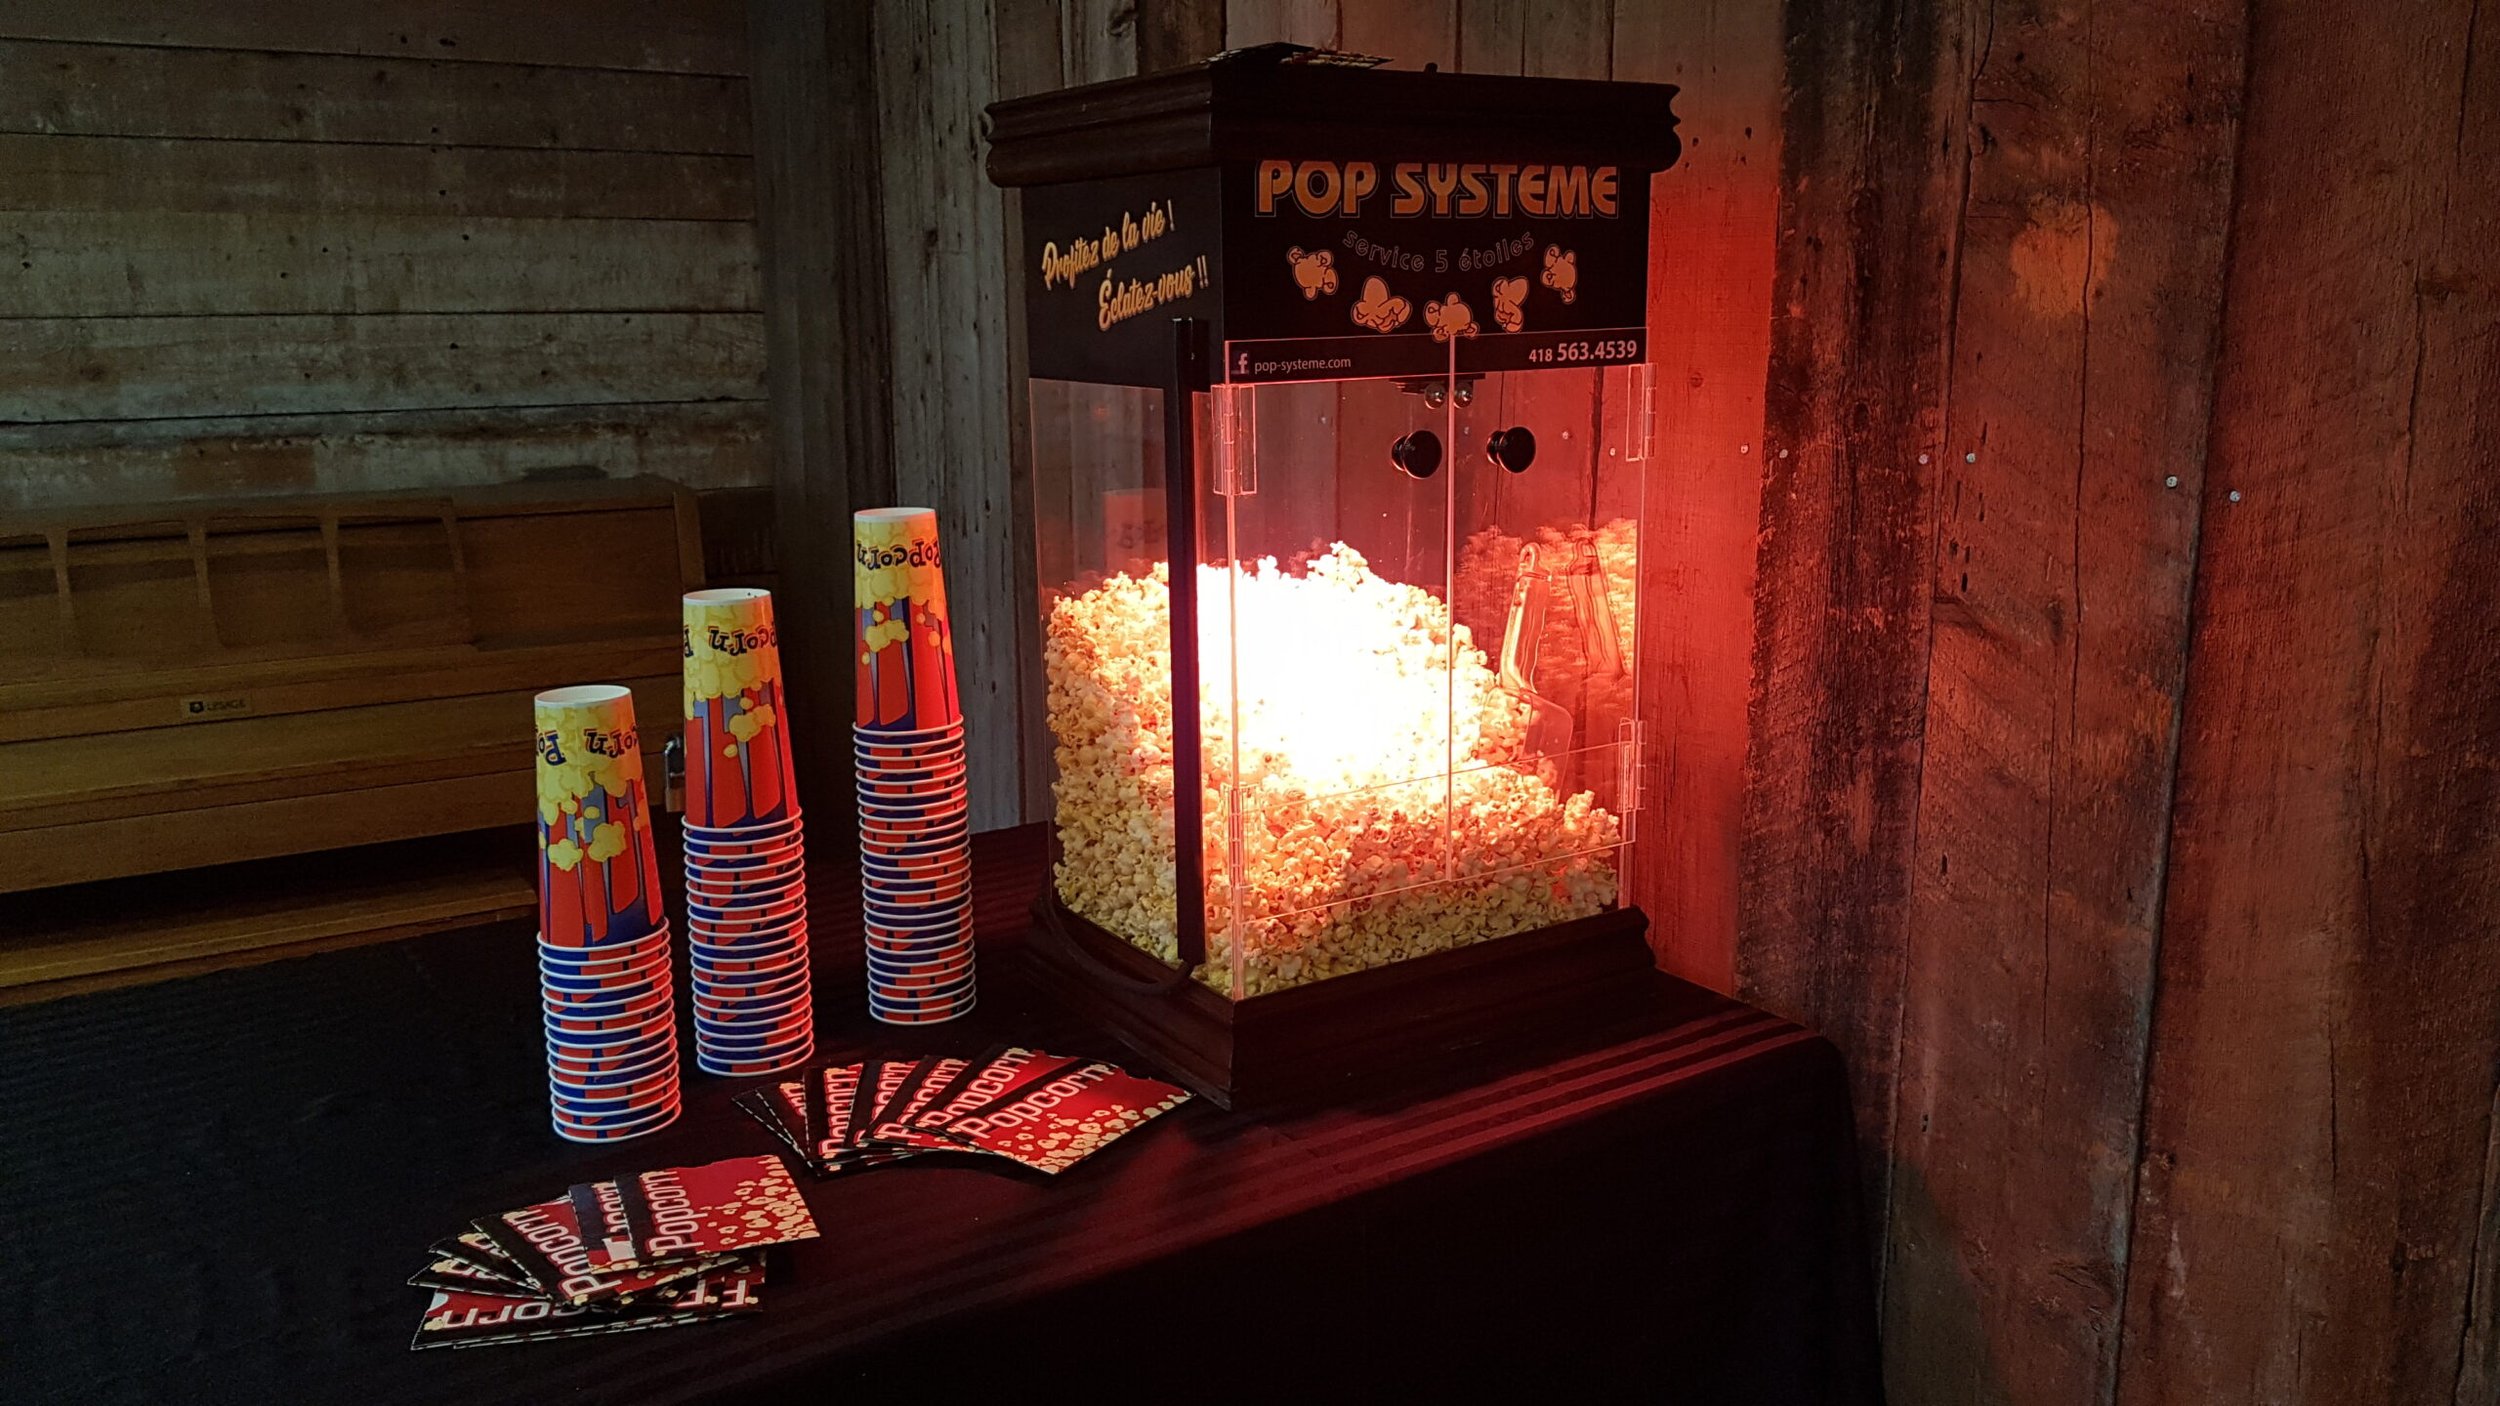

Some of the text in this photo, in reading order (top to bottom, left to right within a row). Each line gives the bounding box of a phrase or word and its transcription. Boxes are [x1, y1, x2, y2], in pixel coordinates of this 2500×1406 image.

[1255, 160, 1619, 219] POP SYSTEME
[1042, 240, 1100, 291] Profitez
[1102, 226, 1121, 262] de
[1122, 211, 1141, 252] la
[1142, 201, 1166, 243] vie
[1434, 249, 1449, 274] 5
[1458, 231, 1536, 272] étoiles
[1098, 267, 1196, 332] Éclatez-vous
[1254, 356, 1352, 375] pop-systeme.com
[1528, 340, 1638, 363] 418 563.4539
[953, 1063, 1116, 1139] Popcorn
[641, 1170, 709, 1253] Popcorn
